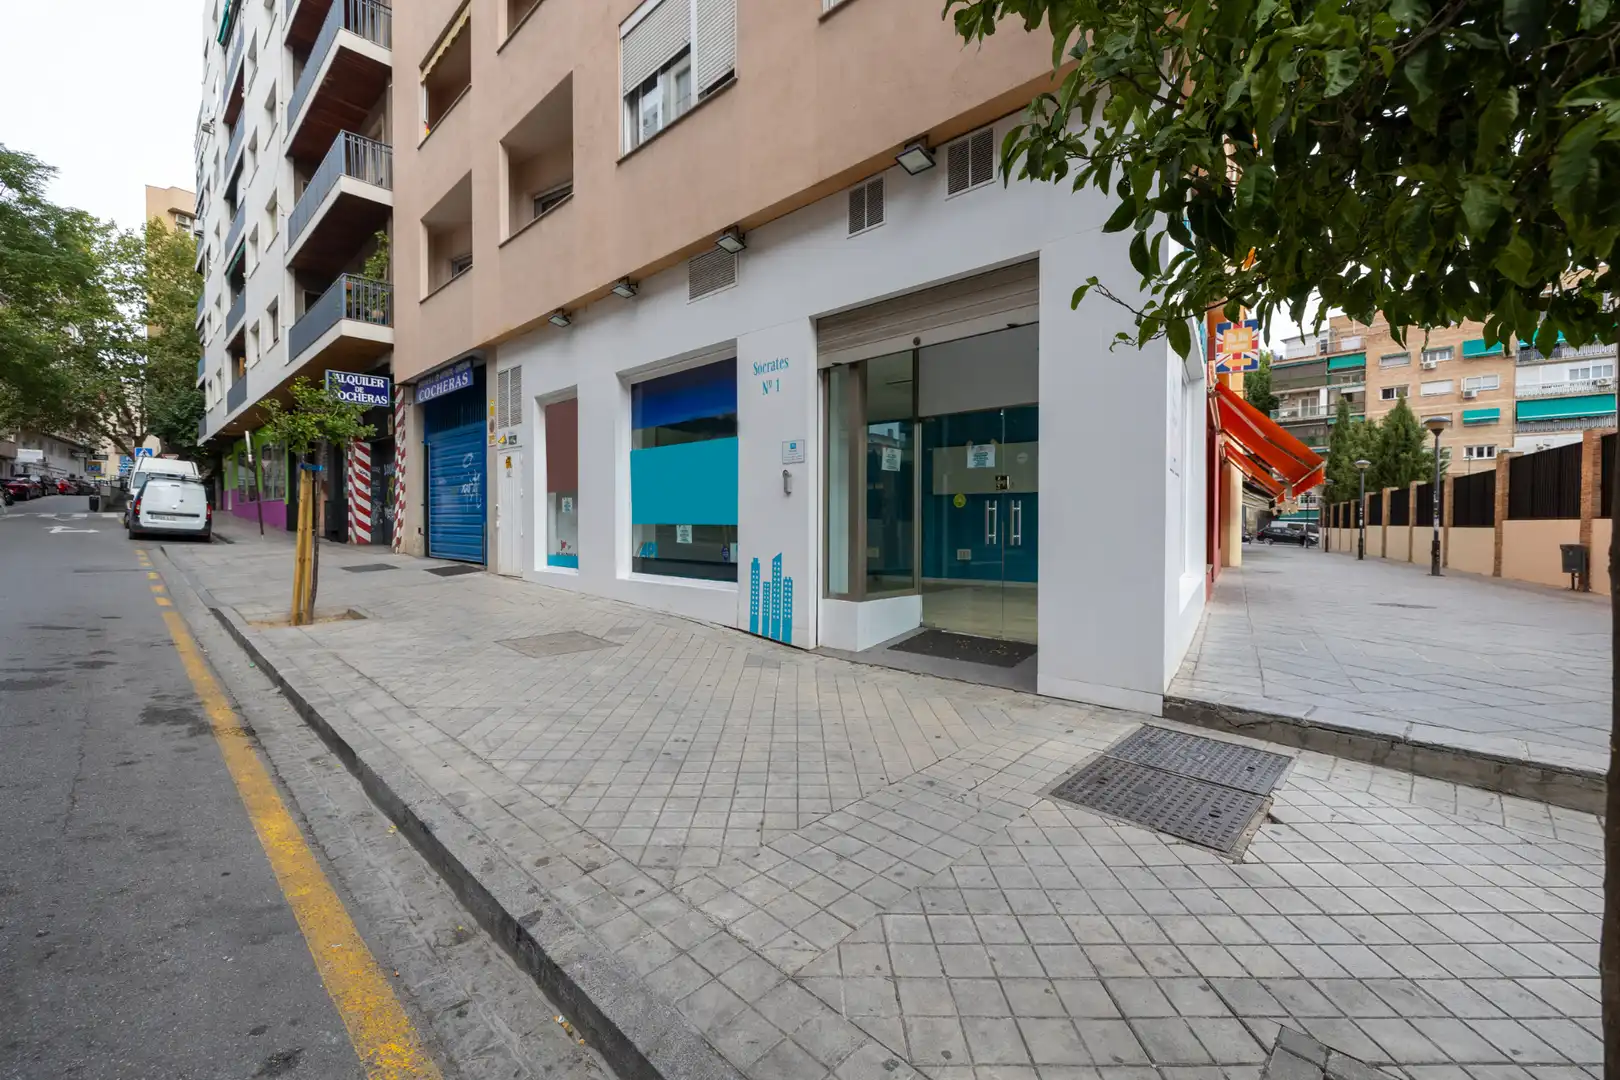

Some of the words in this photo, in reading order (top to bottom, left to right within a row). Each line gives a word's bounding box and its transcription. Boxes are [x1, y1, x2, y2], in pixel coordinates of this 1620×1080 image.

[354, 386, 365, 394] DE
[418, 372, 468, 401] COCHERAS
[337, 391, 388, 405] OCHERAS
